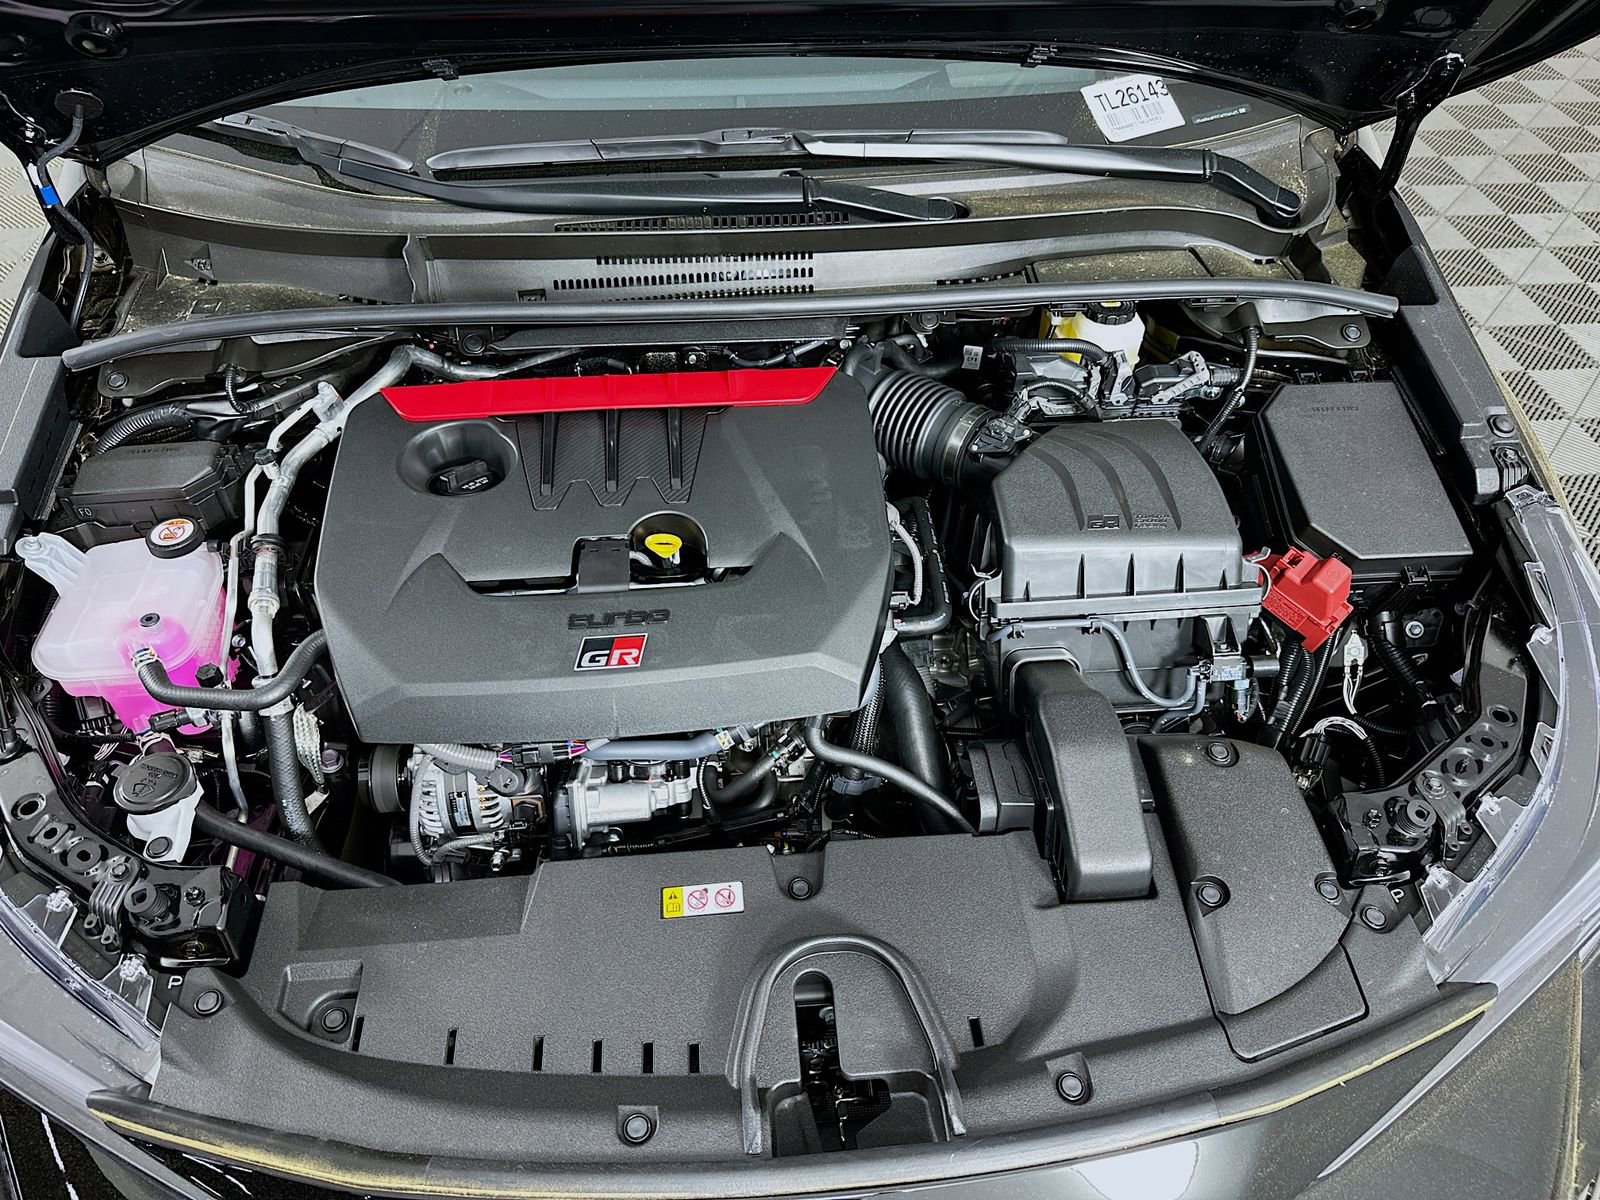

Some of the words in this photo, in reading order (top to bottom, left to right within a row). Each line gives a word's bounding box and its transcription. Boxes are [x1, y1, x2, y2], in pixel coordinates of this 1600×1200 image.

[1093, 79, 1170, 112] TL26143
[580, 647, 641, 668] GR
[1390, 888, 1405, 903] P
[167, 975, 183, 989] P
